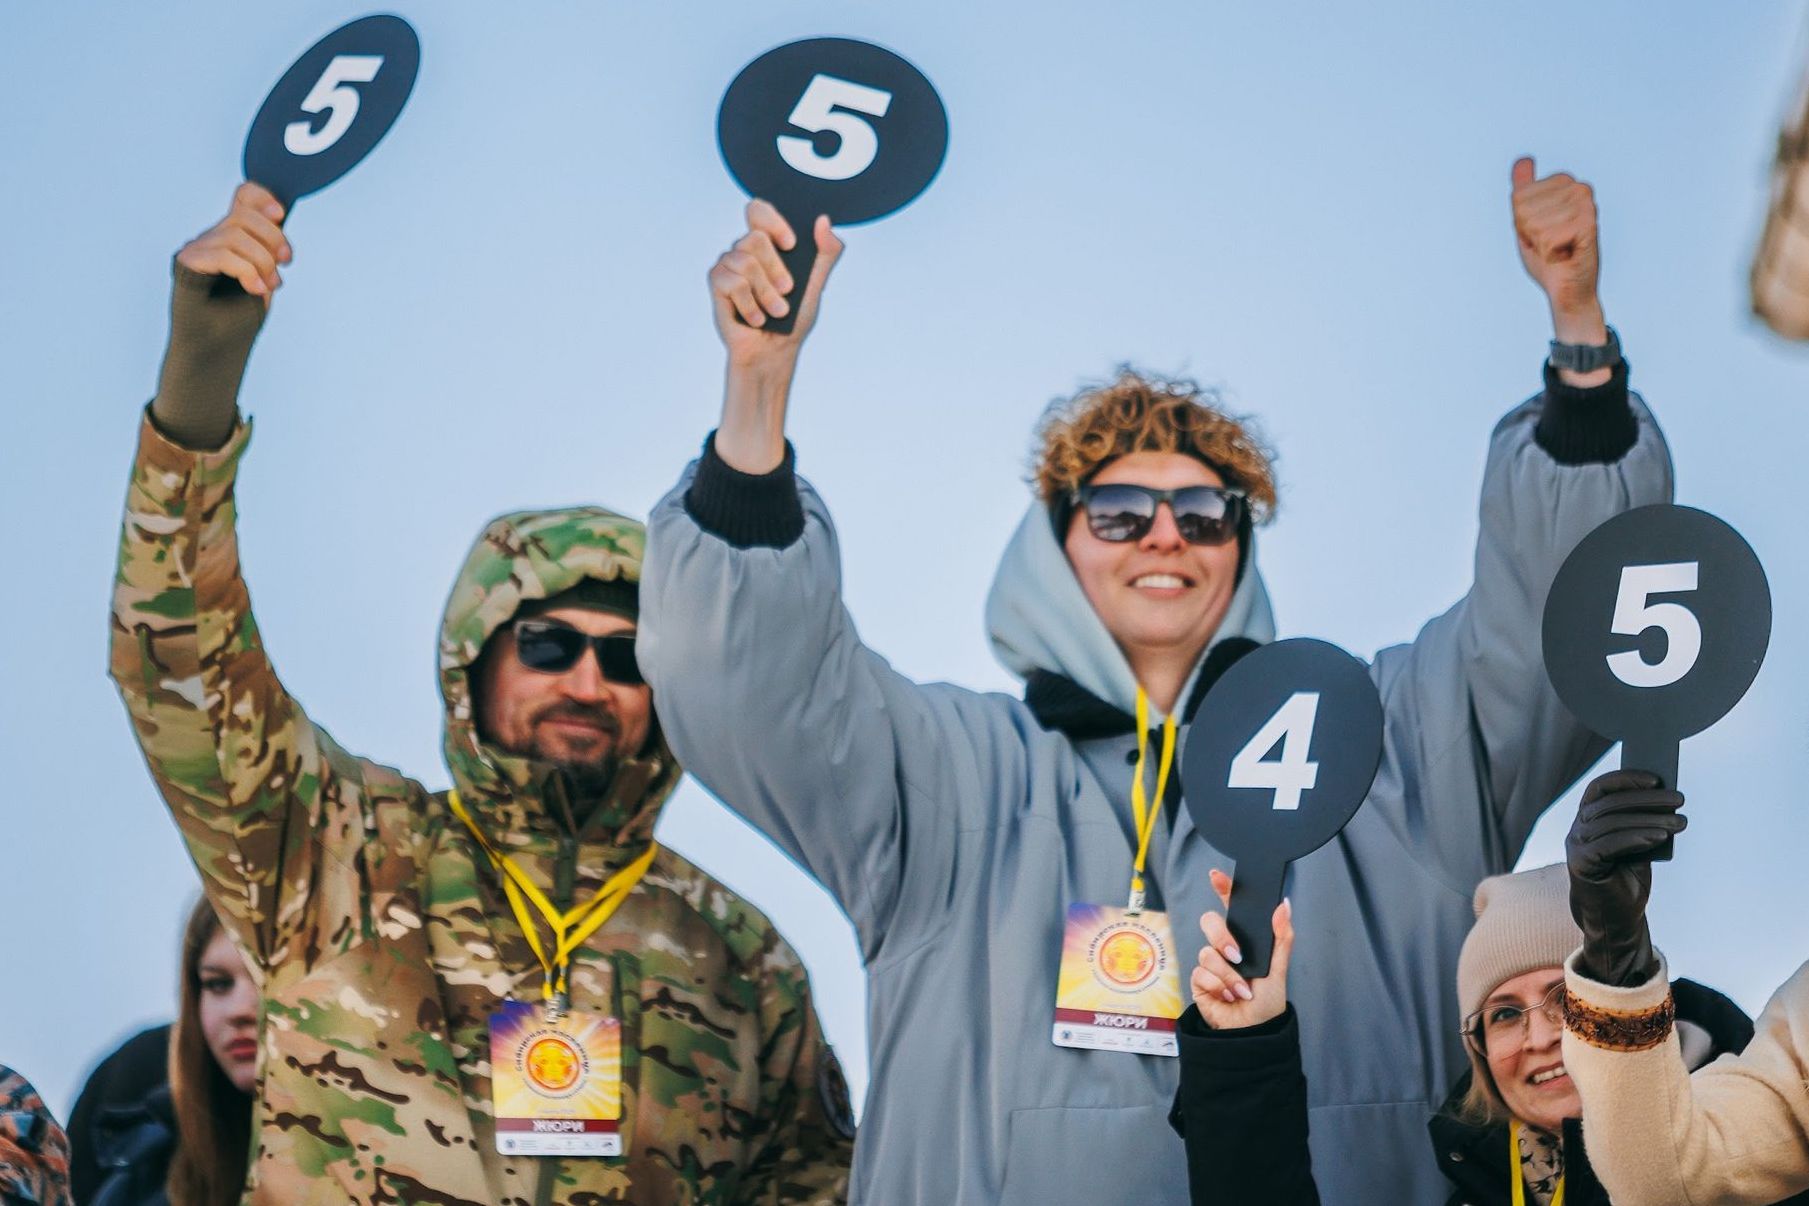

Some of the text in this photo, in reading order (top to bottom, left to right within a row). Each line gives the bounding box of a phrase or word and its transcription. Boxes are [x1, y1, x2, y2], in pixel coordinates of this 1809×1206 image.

[284, 54, 384, 155] 5
[777, 75, 892, 181] 5
[1606, 561, 1703, 688] 5
[1227, 692, 1319, 811] 4
[1094, 1013, 1148, 1029] ЖЮРИ
[532, 1120, 585, 1132] ЖЮРИ
